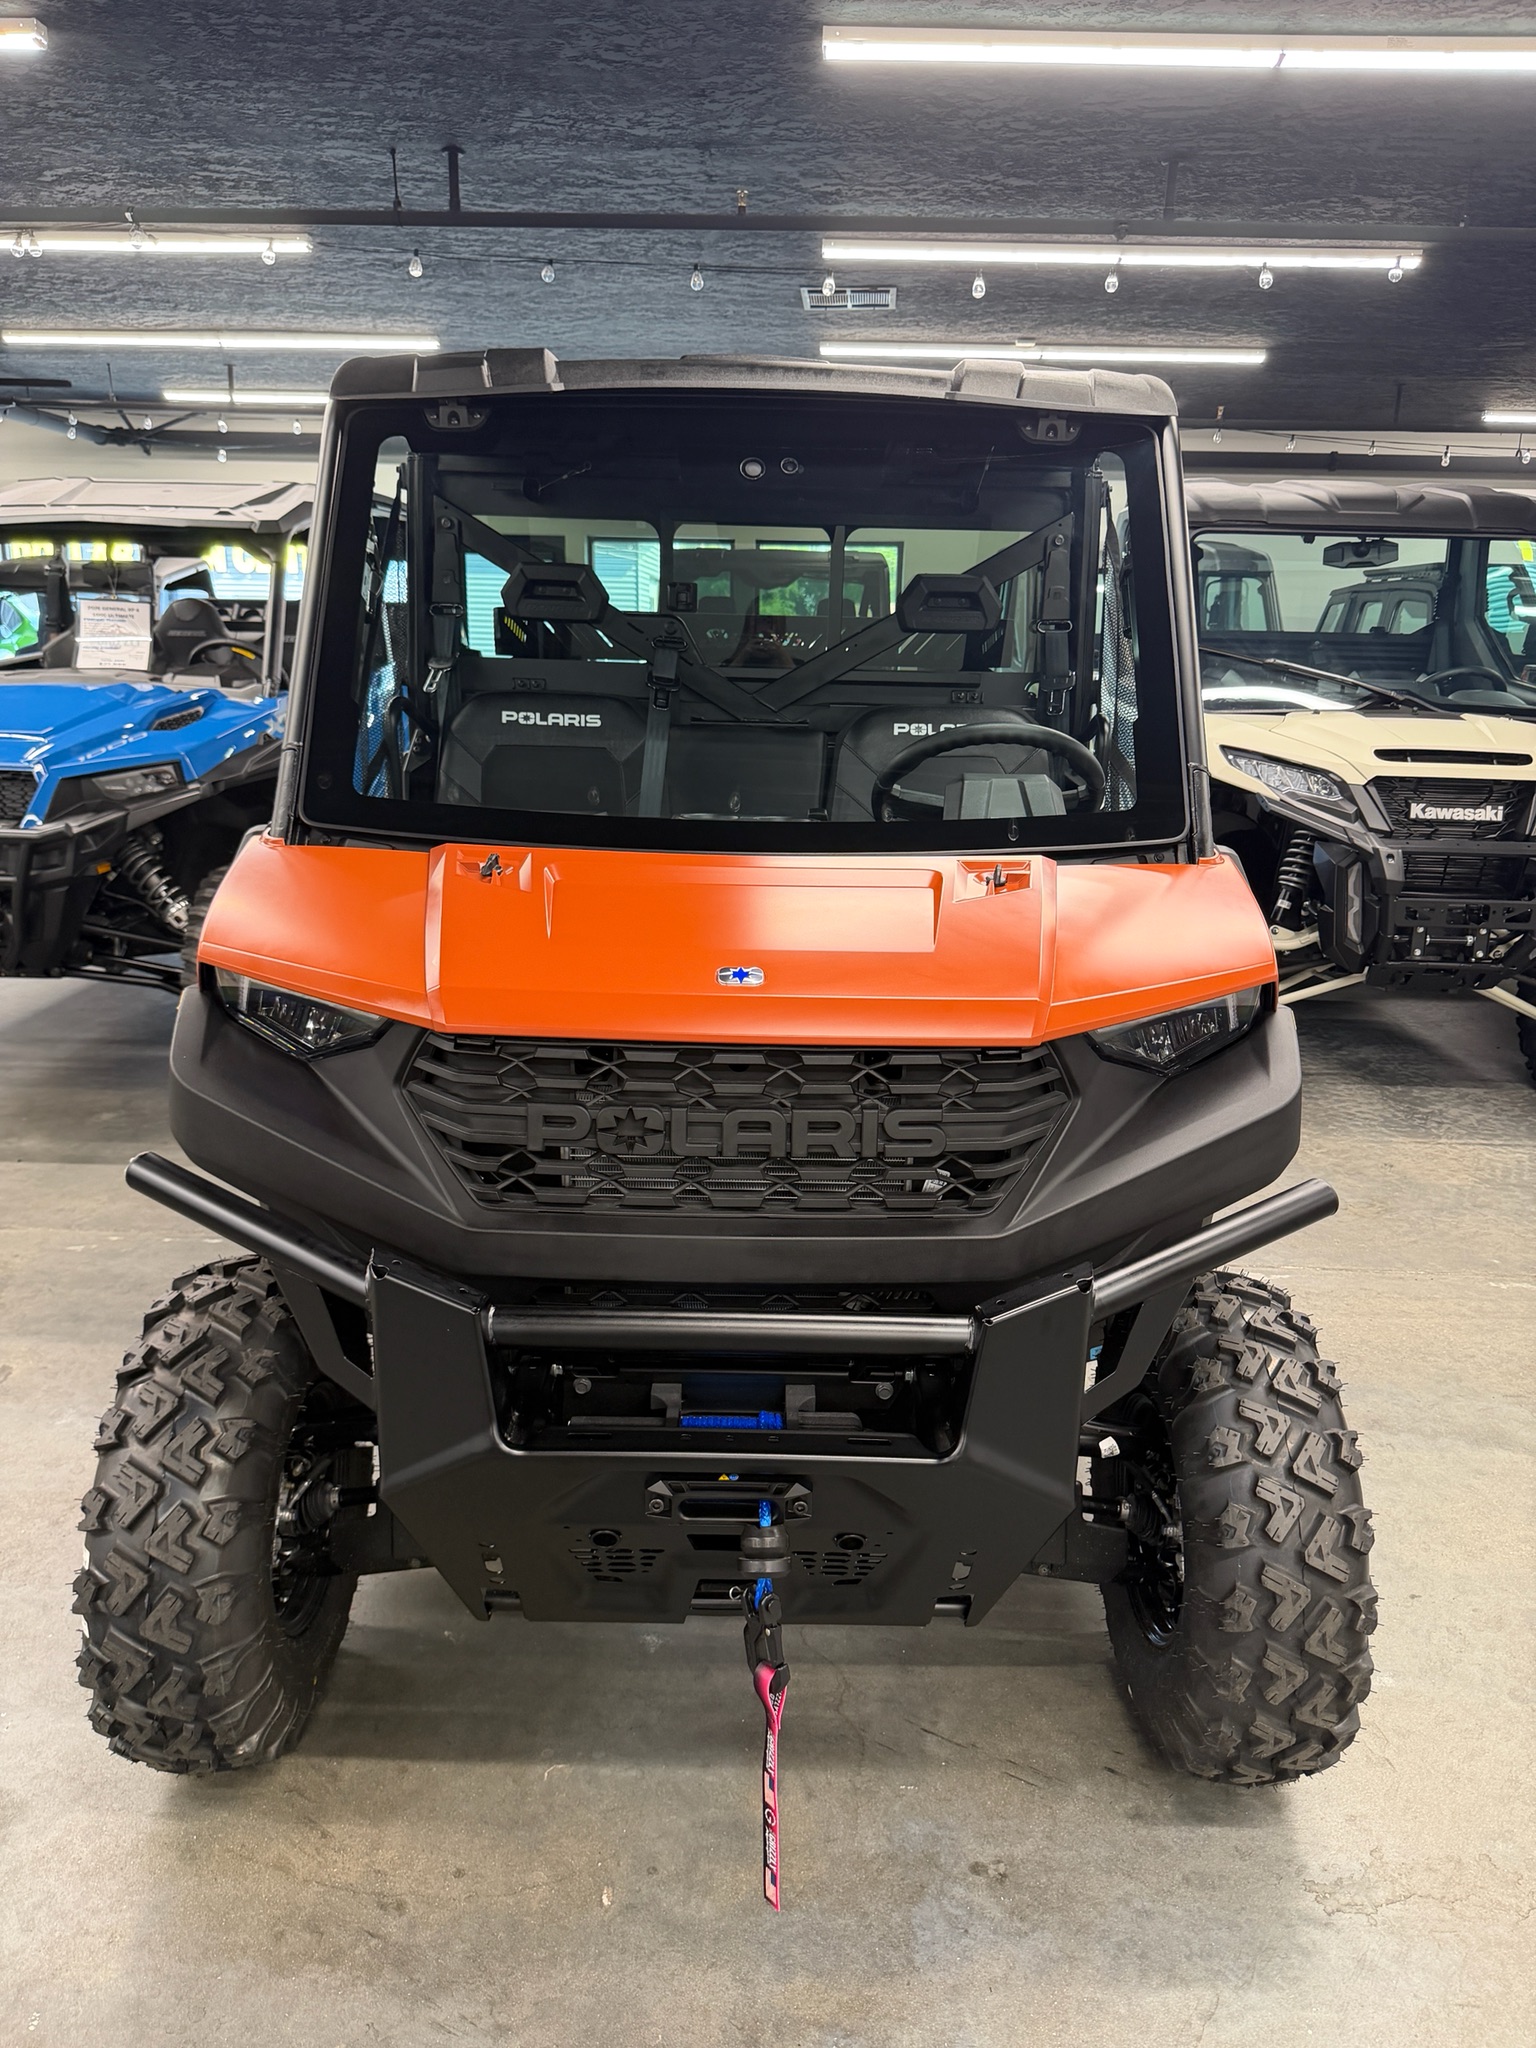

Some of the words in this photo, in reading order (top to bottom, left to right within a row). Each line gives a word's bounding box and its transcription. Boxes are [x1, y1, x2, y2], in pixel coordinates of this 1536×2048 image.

[501, 710, 602, 727] POLARIS
[1409, 802, 1504, 822] Kawasaki
[526, 1102, 947, 1158] POLARIS
